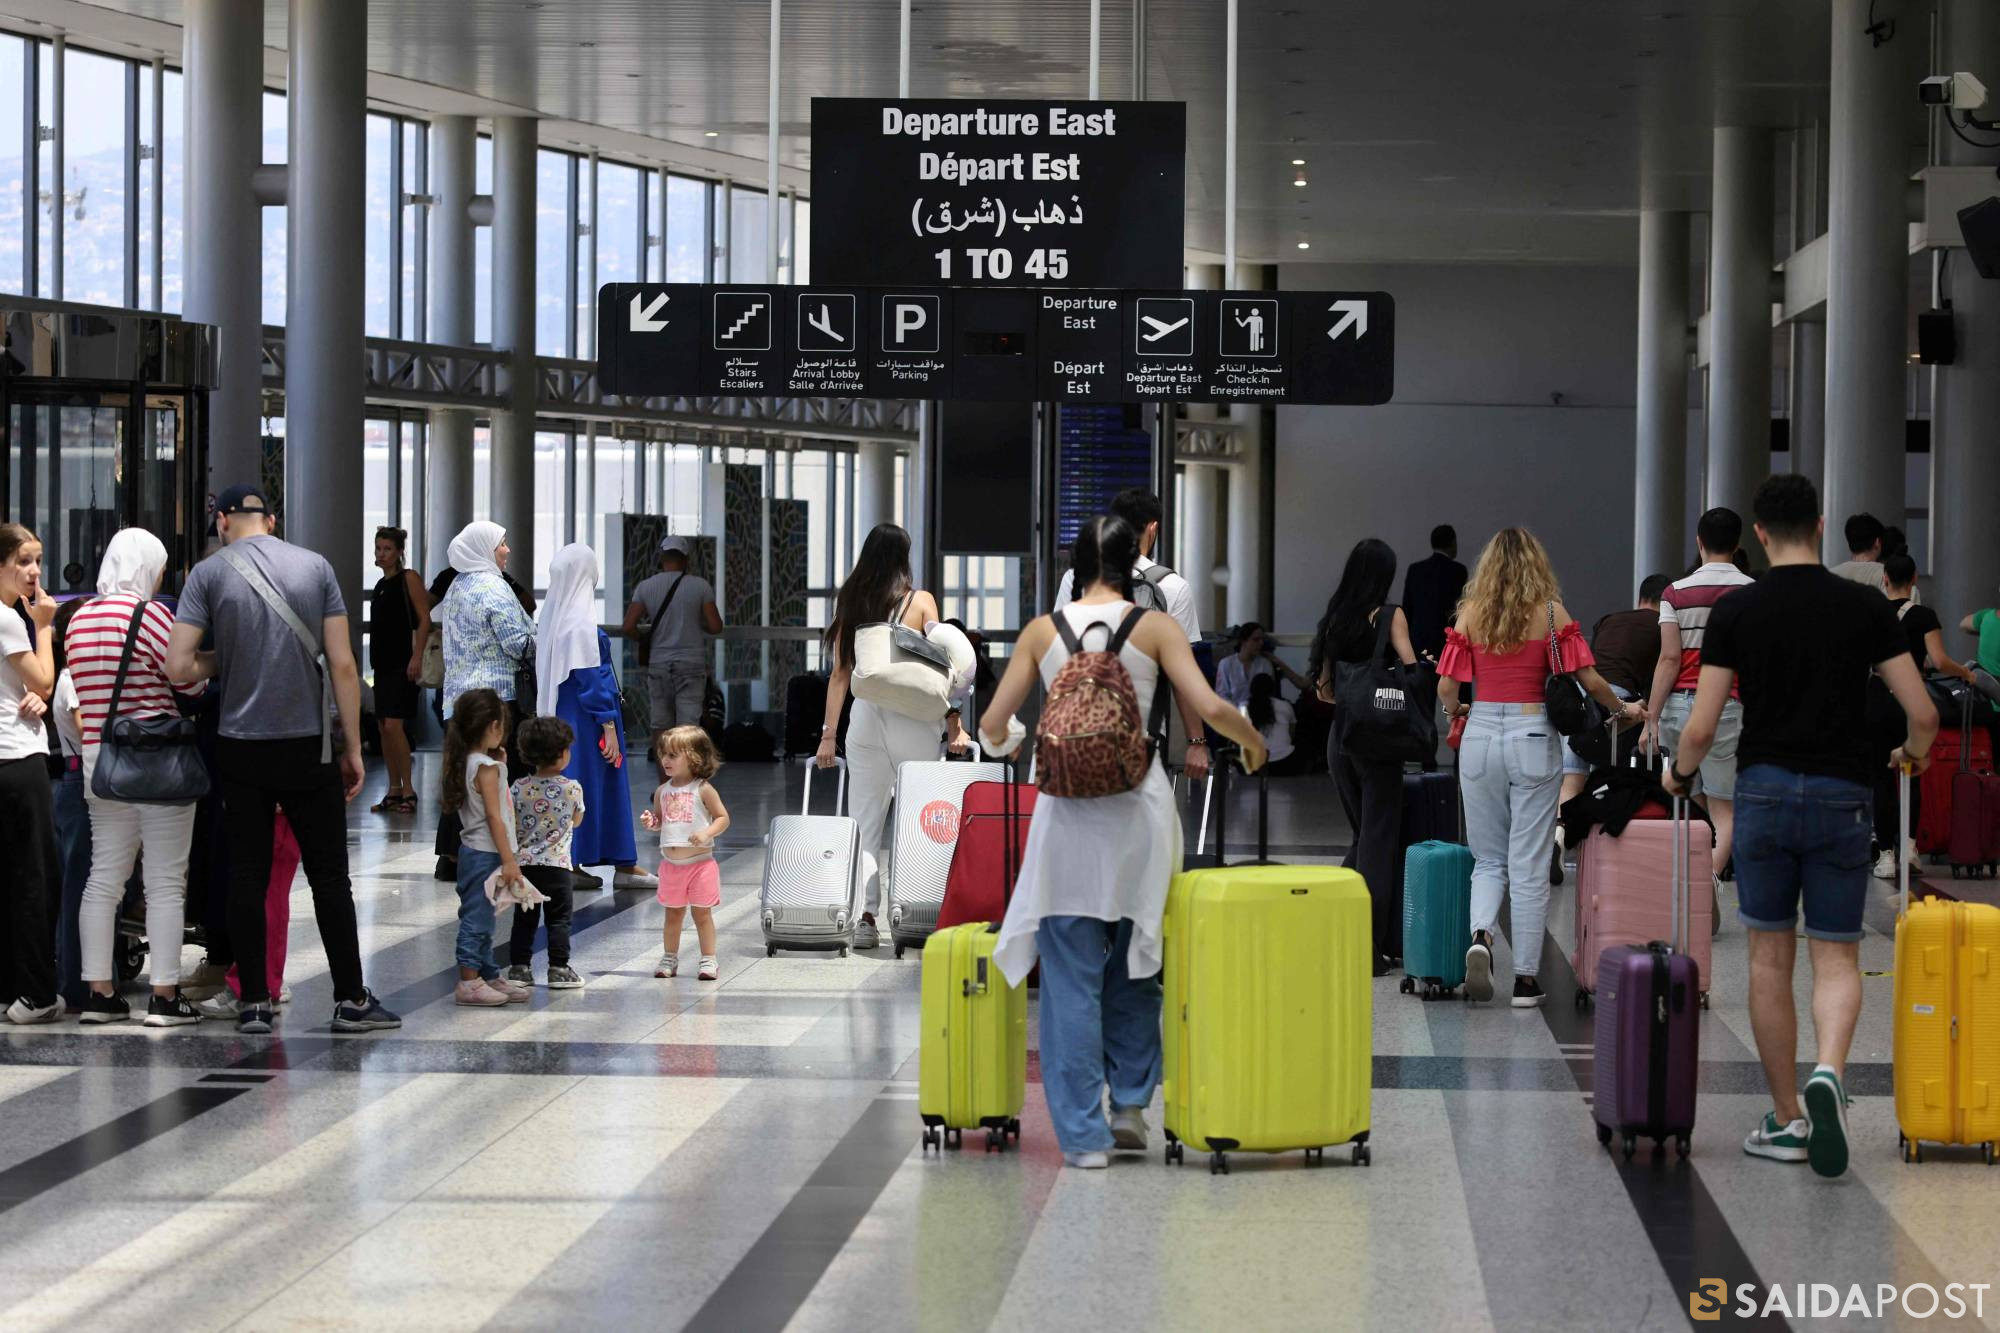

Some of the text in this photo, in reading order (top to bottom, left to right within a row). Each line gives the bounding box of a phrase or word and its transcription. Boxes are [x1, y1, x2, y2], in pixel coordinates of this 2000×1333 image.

[882, 107, 1116, 141] Departure East
[919, 151, 1080, 186] Départ Est
[911, 194, 1083, 238] ذهاب (شرق)
[934, 248, 1069, 280] 1 TO 45
[1043, 295, 1118, 312] Departure
[895, 304, 927, 343] P
[1063, 316, 1096, 329] East
[796, 357, 857, 369] قاعة الوصول
[876, 359, 945, 371] مواقف سيارات
[1053, 360, 1105, 376] Départ
[1166, 362, 1194, 373] ذهاب
[1214, 363, 1284, 375] تسجيل التذاكر
[727, 368, 757, 378] Stairs
[792, 369, 861, 381] Arrival Lobby
[892, 370, 929, 381] Parking
[1126, 373, 1202, 384] Departure East
[1226, 374, 1270, 384] Check-In
[720, 379, 764, 389] Escaliers
[788, 380, 864, 391] Salle d'Arrivée
[1067, 381, 1091, 394] Est
[1136, 384, 1193, 396] Départ Est
[1210, 385, 1286, 397] Enregistrement
[1375, 687, 1405, 701] PUMA
